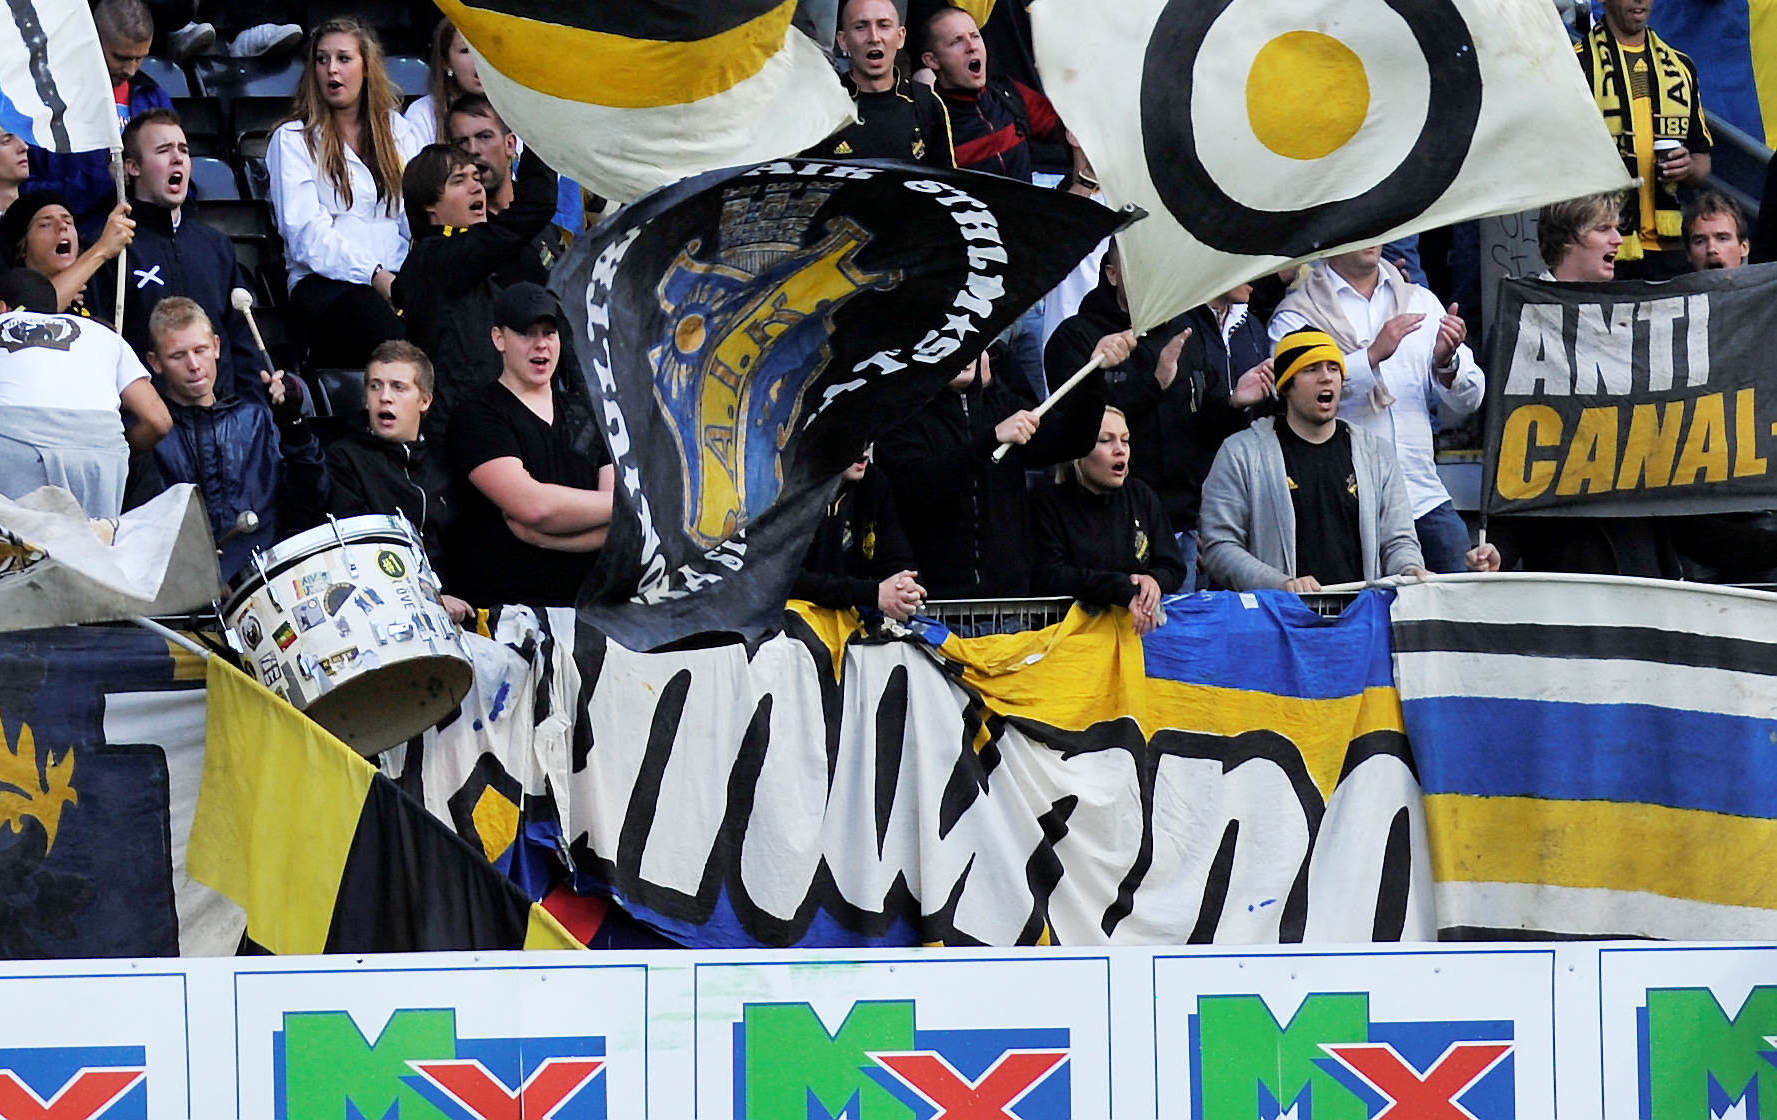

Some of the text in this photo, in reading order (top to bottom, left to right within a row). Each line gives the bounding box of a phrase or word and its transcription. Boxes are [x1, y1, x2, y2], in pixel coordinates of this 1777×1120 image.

[1659, 117, 1690, 136] 189
[1503, 292, 1711, 396] ANTI
[1496, 387, 1777, 501] CANAL
[1636, 985, 1777, 1120] M
